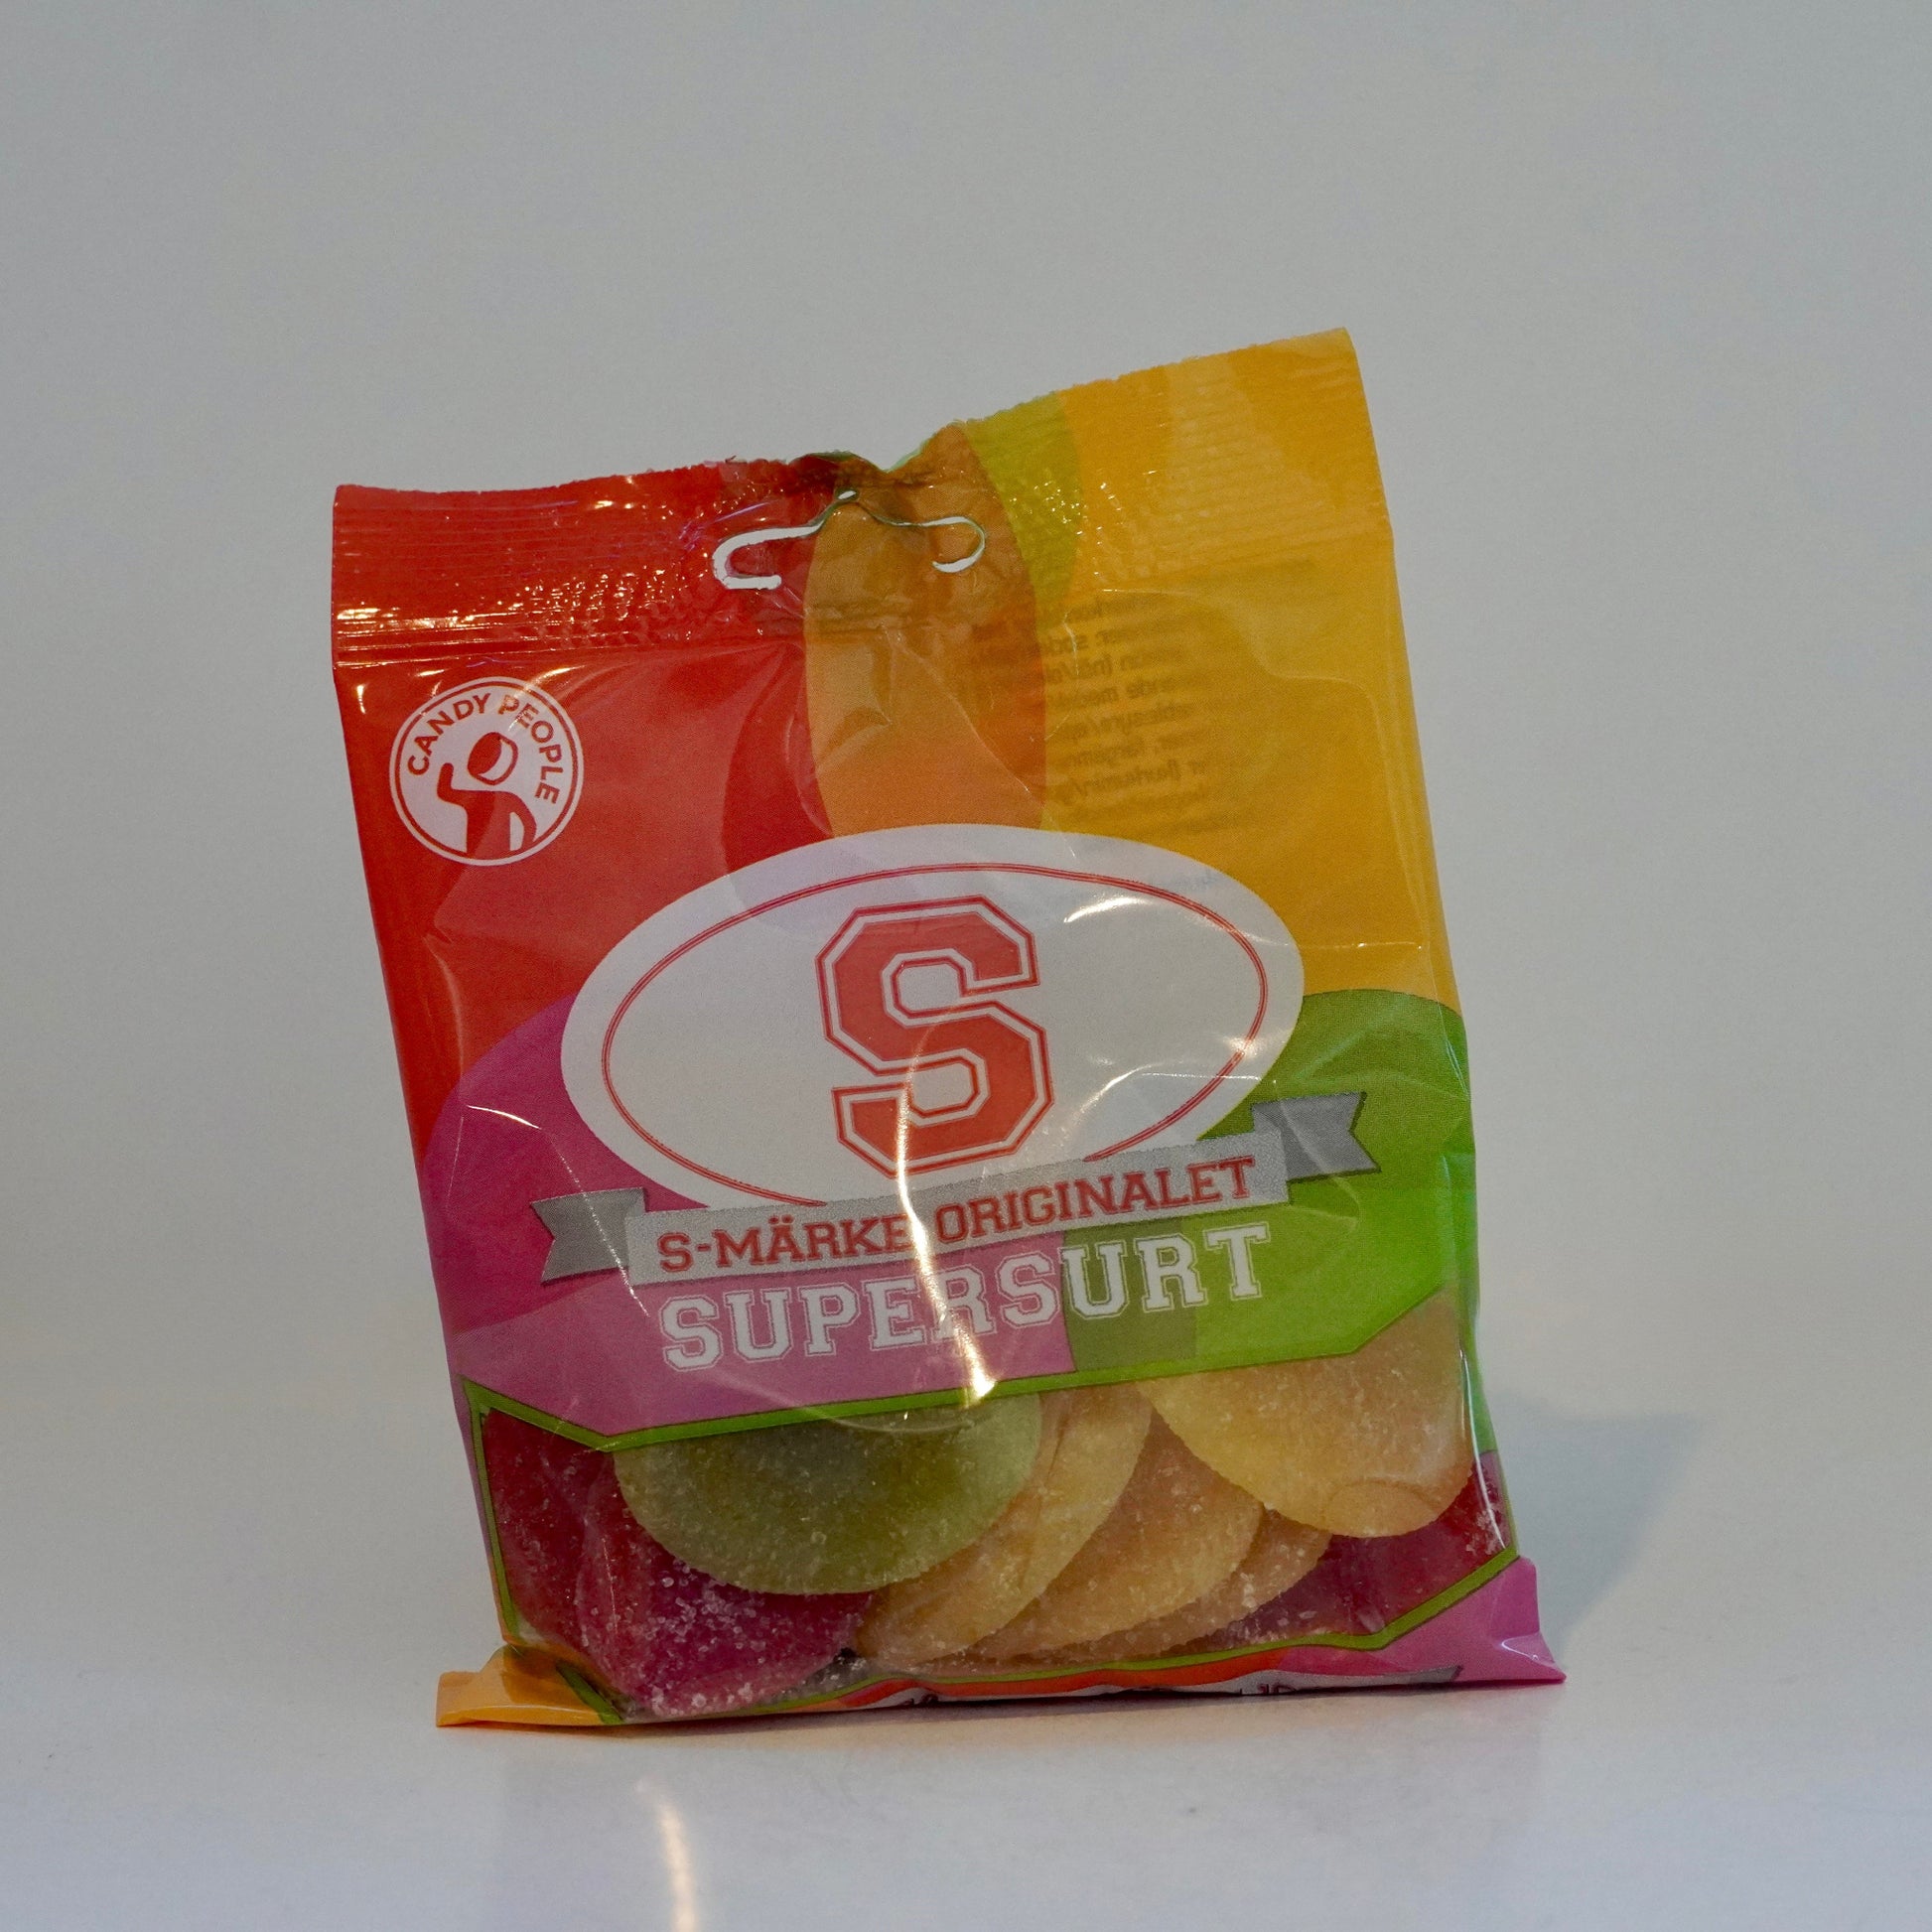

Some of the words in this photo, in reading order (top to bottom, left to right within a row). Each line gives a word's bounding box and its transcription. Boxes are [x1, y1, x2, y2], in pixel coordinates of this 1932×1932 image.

[406, 692, 491, 776] CANDY
[497, 694, 564, 805] PEOPLE
[814, 895, 1054, 1179] S
[656, 1213, 917, 1273] S-MÄRKE
[934, 1156, 1255, 1244] ORIGINALET
[658, 1222, 1270, 1372] SUPERSURT
